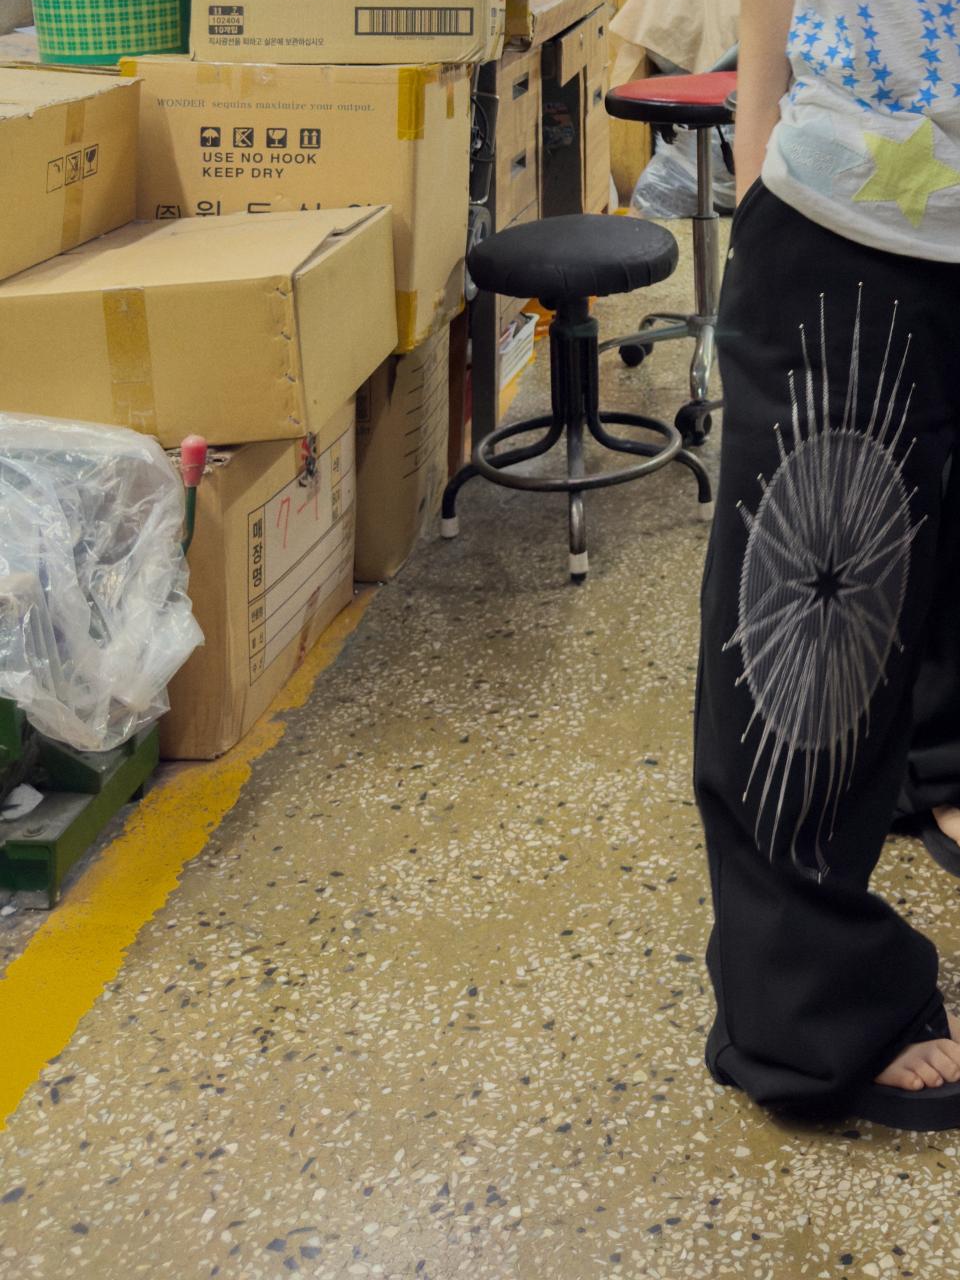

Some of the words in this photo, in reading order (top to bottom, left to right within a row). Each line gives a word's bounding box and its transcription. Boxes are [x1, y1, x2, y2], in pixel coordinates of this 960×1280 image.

[156, 98, 205, 108] WONDER
[212, 101, 253, 110] sequins
[256, 101, 306, 110] maximize
[310, 103, 333, 112] your
[203, 152, 234, 163] USE
[241, 153, 264, 164] NO
[270, 153, 316, 164] HOOK
[202, 167, 244, 178] KEEP
[251, 168, 285, 179] DRY
